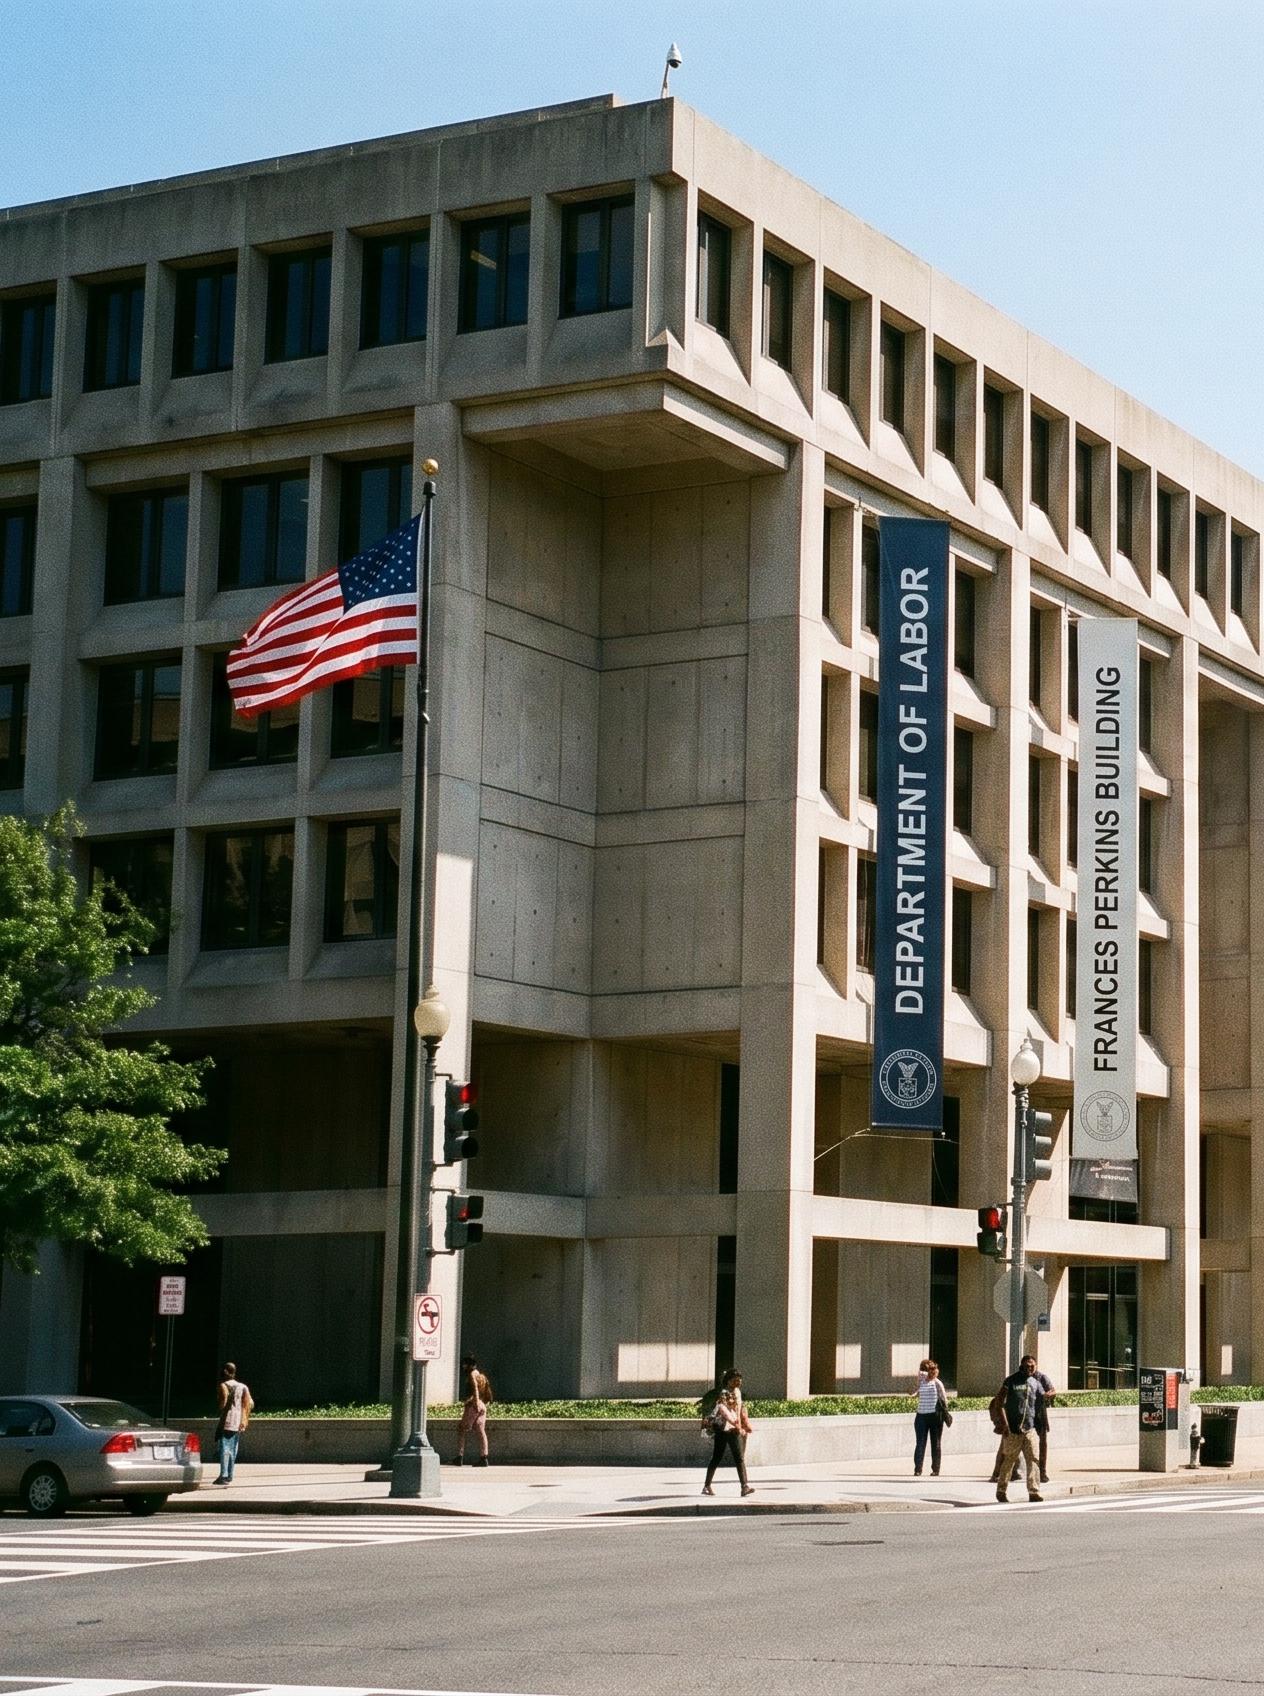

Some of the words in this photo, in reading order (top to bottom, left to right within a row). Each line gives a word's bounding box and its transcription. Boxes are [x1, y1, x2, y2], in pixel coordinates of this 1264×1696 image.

[899, 567, 929, 693] LABOR
[898, 704, 928, 754] OF
[1095, 667, 1121, 800] BUILDING
[895, 764, 927, 1014] DEPARTMENT
[1094, 810, 1120, 930] PERKINS
[1093, 940, 1119, 1072] FRANCES
